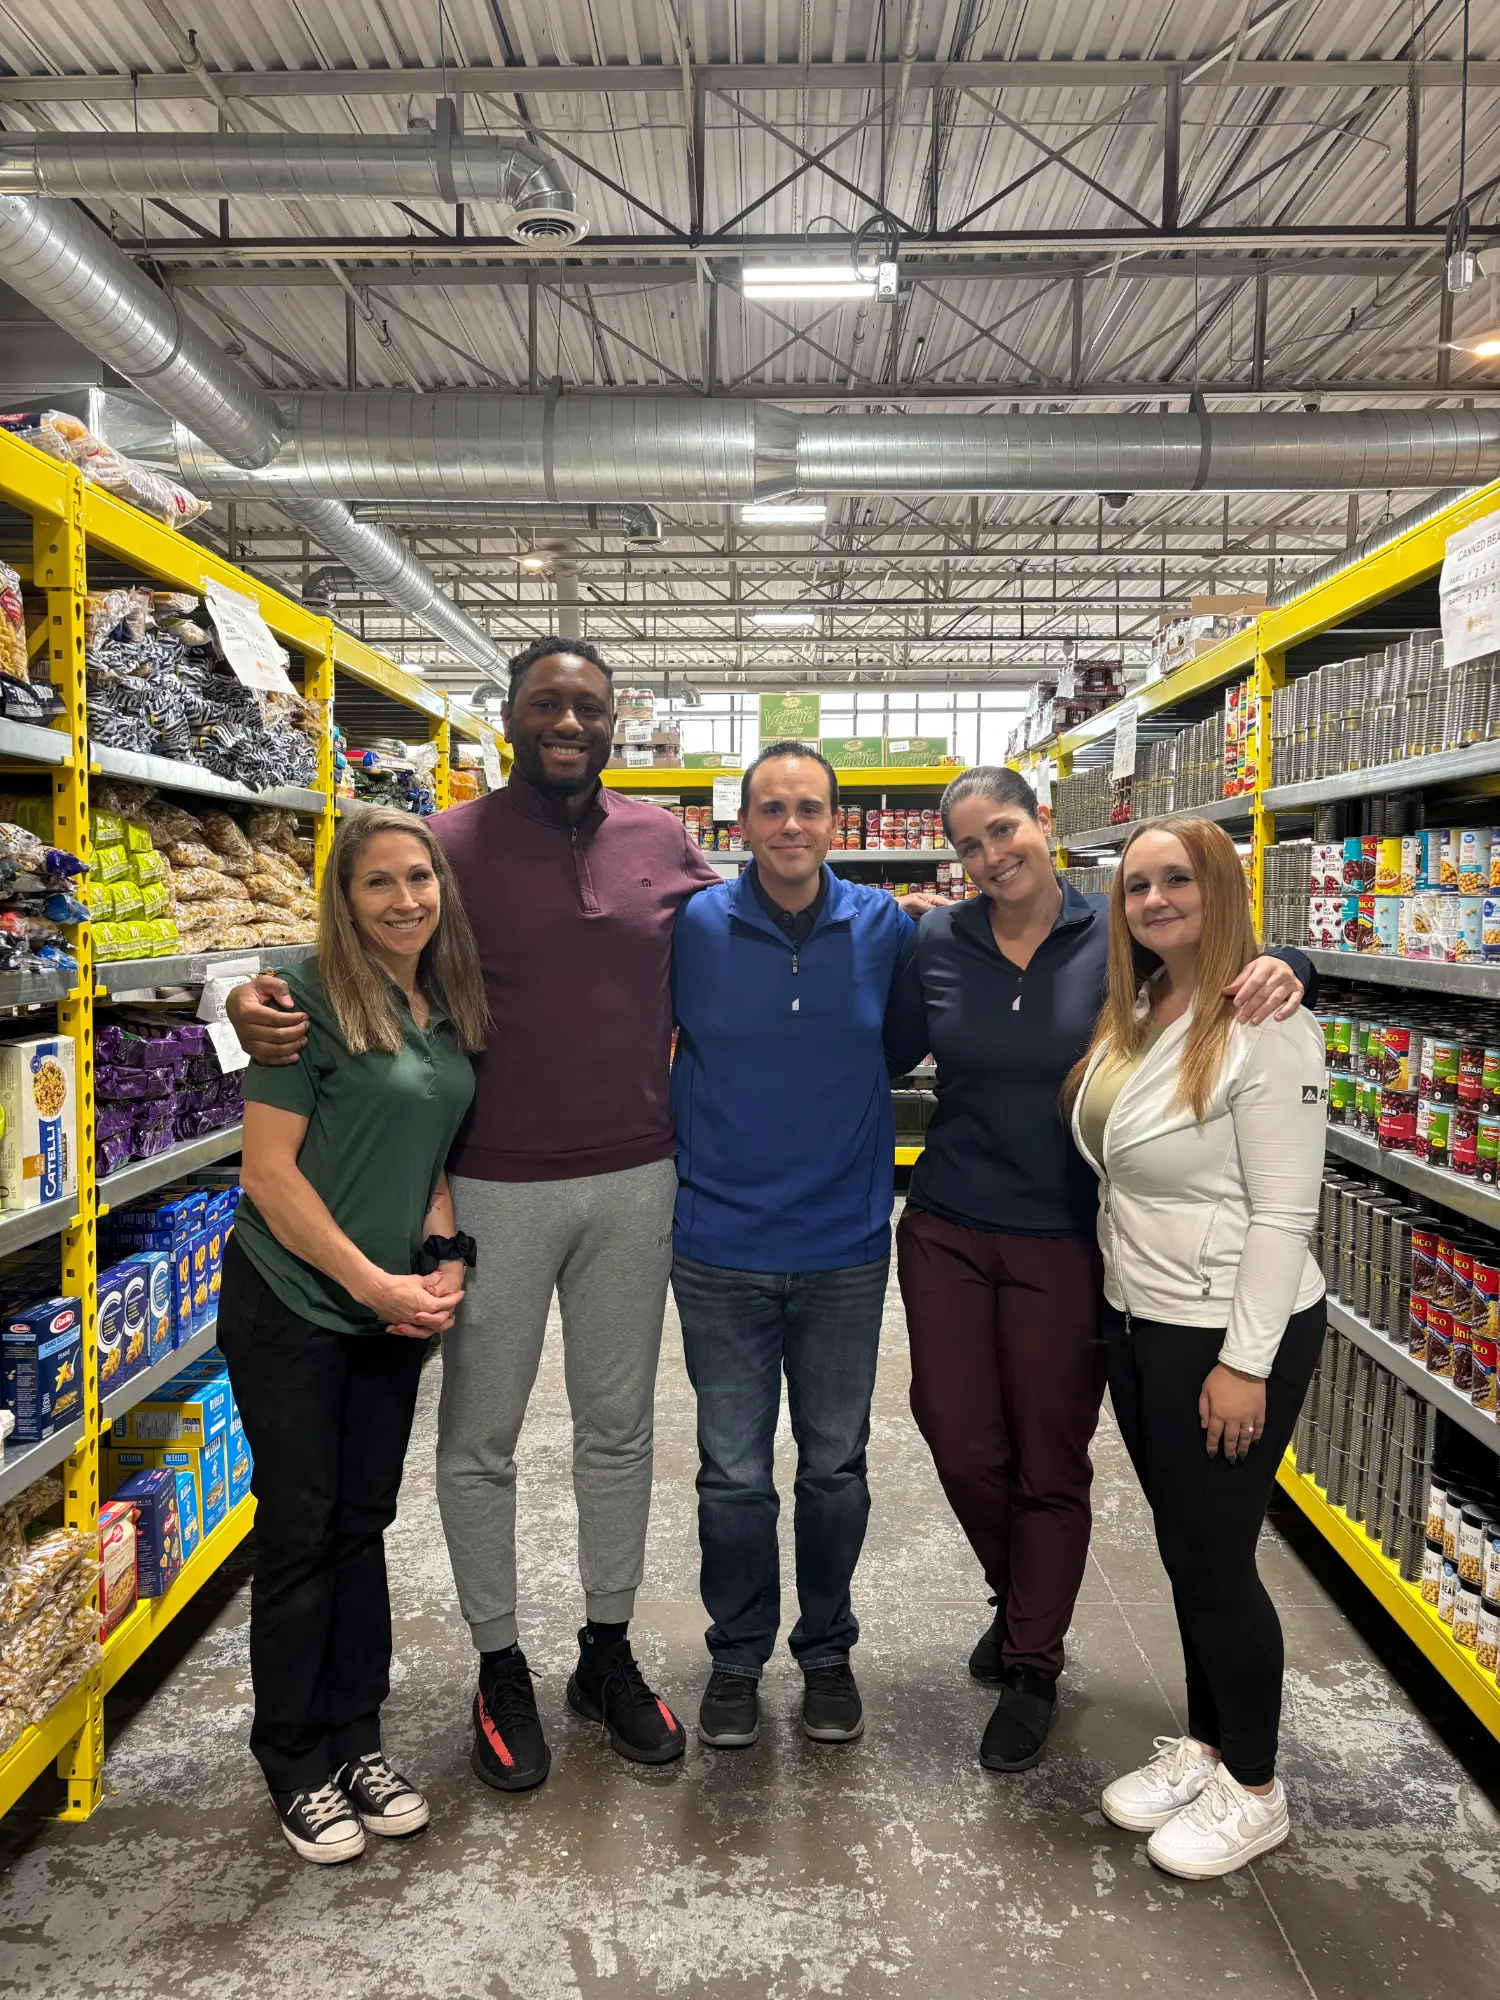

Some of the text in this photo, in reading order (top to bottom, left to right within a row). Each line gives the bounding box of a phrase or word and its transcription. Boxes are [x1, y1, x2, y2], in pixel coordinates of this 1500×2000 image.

[1457, 539, 1485, 562] CANNED
[1474, 567, 1480, 578] 2
[1482, 563, 1487, 574] 3
[1491, 560, 1495, 570] 4
[1467, 592, 1472, 604] 2
[1475, 589, 1480, 600] 2
[1483, 586, 1488, 597] 2
[1491, 582, 1496, 594] 2
[764, 706, 817, 730] Veggie
[1461, 1065, 1482, 1074] CEDAR
[45, 1125, 57, 1197] CATELLI
[55, 1312, 75, 1329] Barilla
